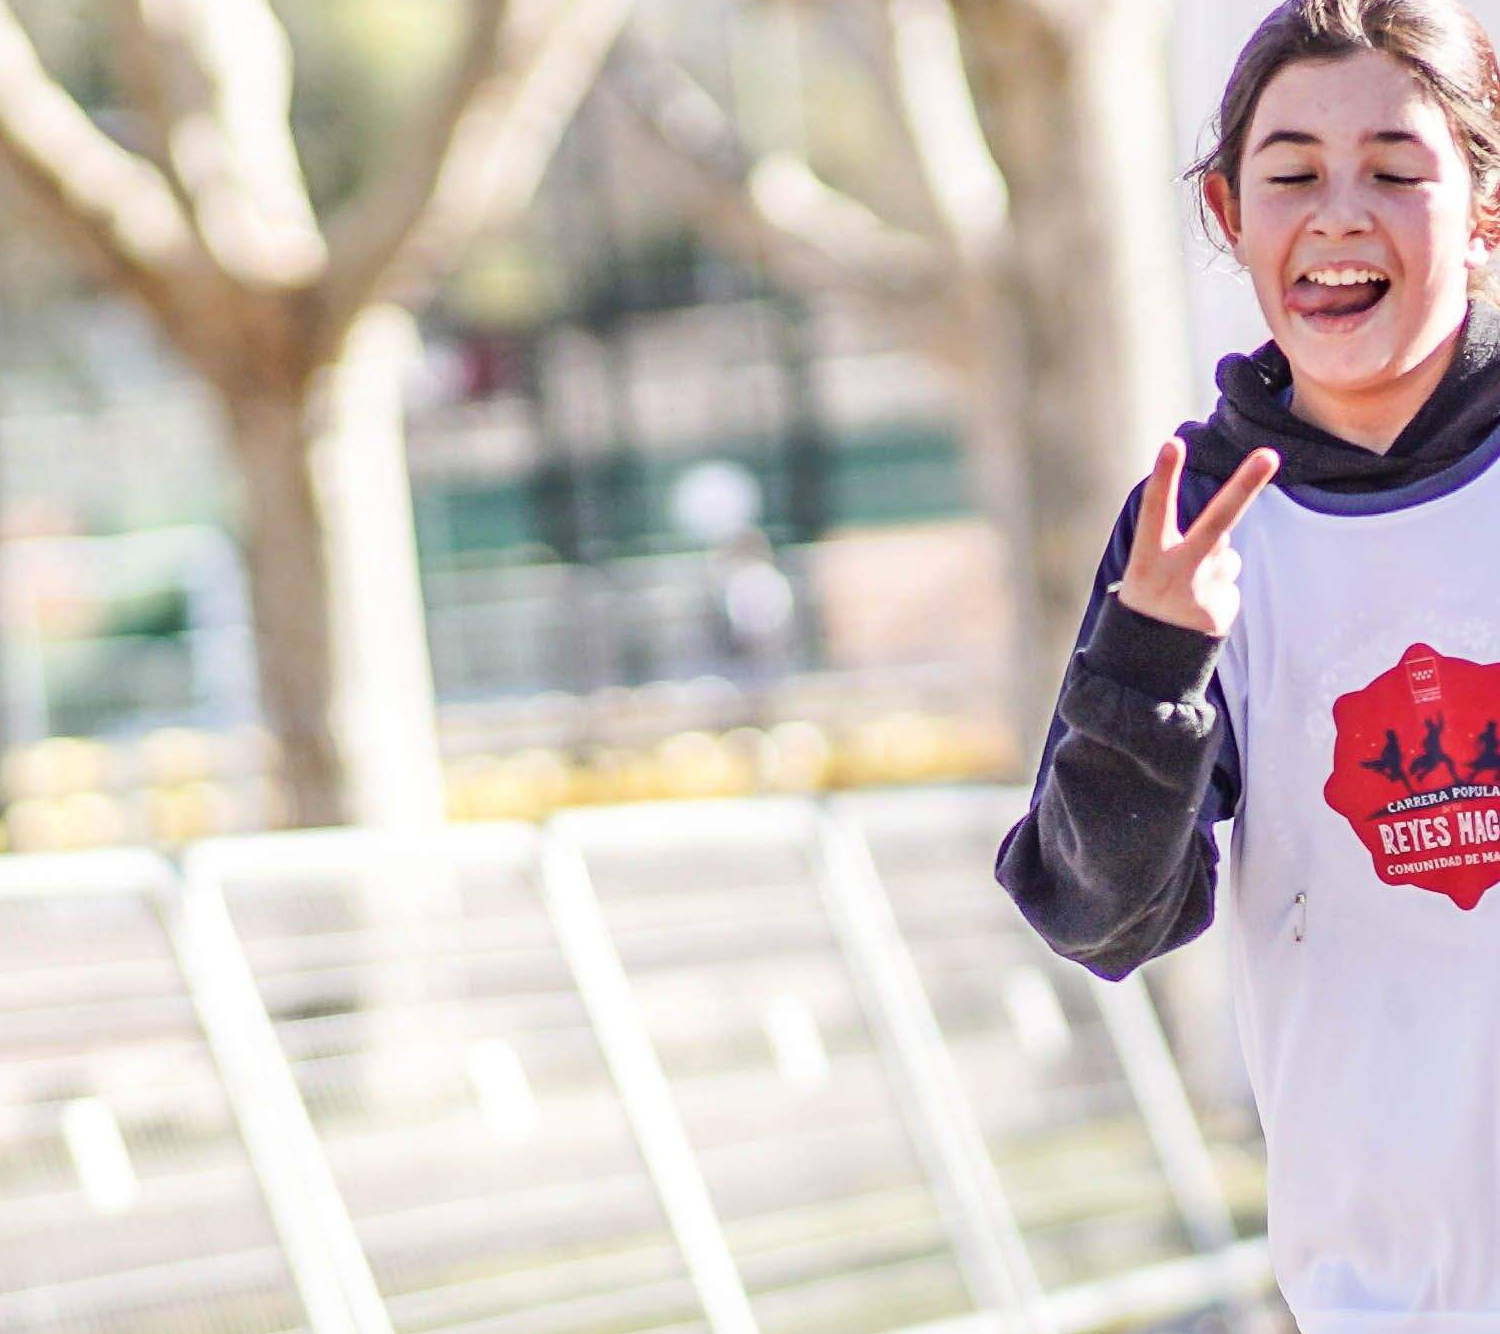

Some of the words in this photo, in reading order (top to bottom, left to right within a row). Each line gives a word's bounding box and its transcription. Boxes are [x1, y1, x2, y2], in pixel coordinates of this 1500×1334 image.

[1387, 790, 1449, 813] CARRERA
[1378, 816, 1451, 855] REYES
[1387, 855, 1462, 876] COMUNIDAD
[1465, 854, 1480, 865] DE
